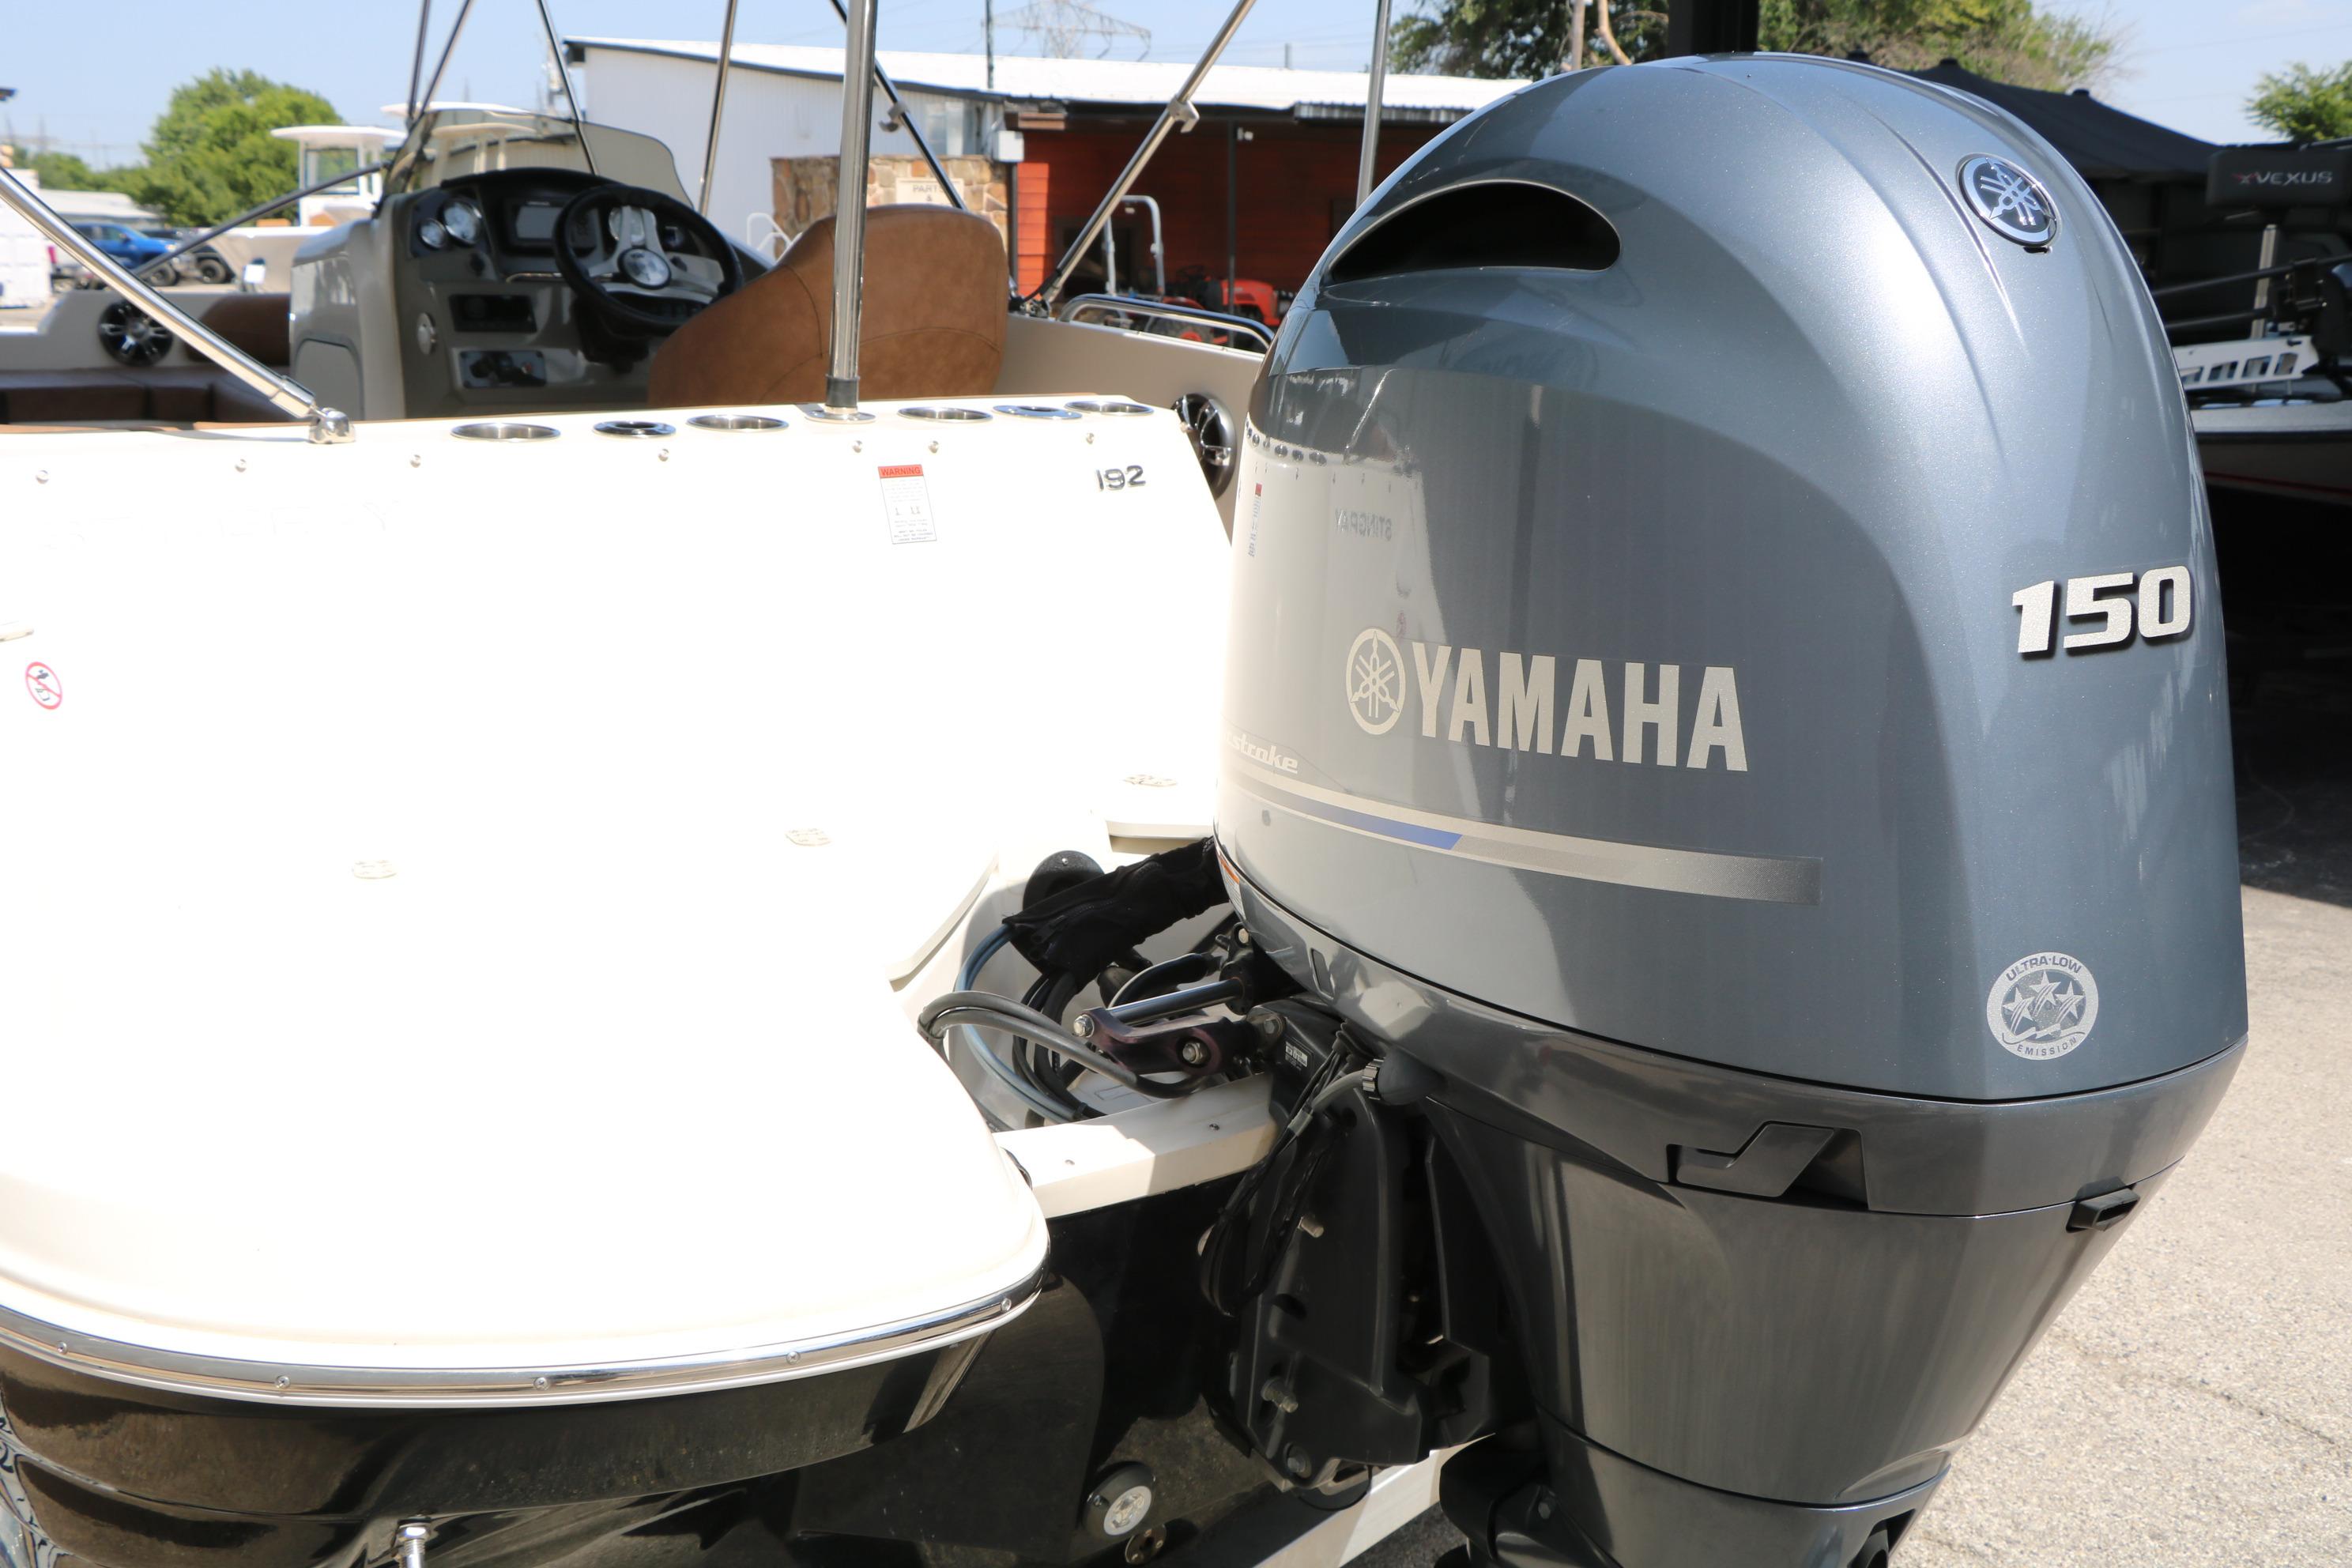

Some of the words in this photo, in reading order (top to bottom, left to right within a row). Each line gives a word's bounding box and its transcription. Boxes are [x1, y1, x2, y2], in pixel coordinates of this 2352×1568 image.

[2255, 171, 2333, 187] VEXUS
[880, 466, 921, 477] WARNING
[1095, 465, 1146, 491] 192
[2012, 565, 2192, 655] 150
[1412, 641, 1748, 772] YAMAHA
[1227, 732, 1298, 775] stroke
[2016, 1036, 2077, 1057] EMISSION
